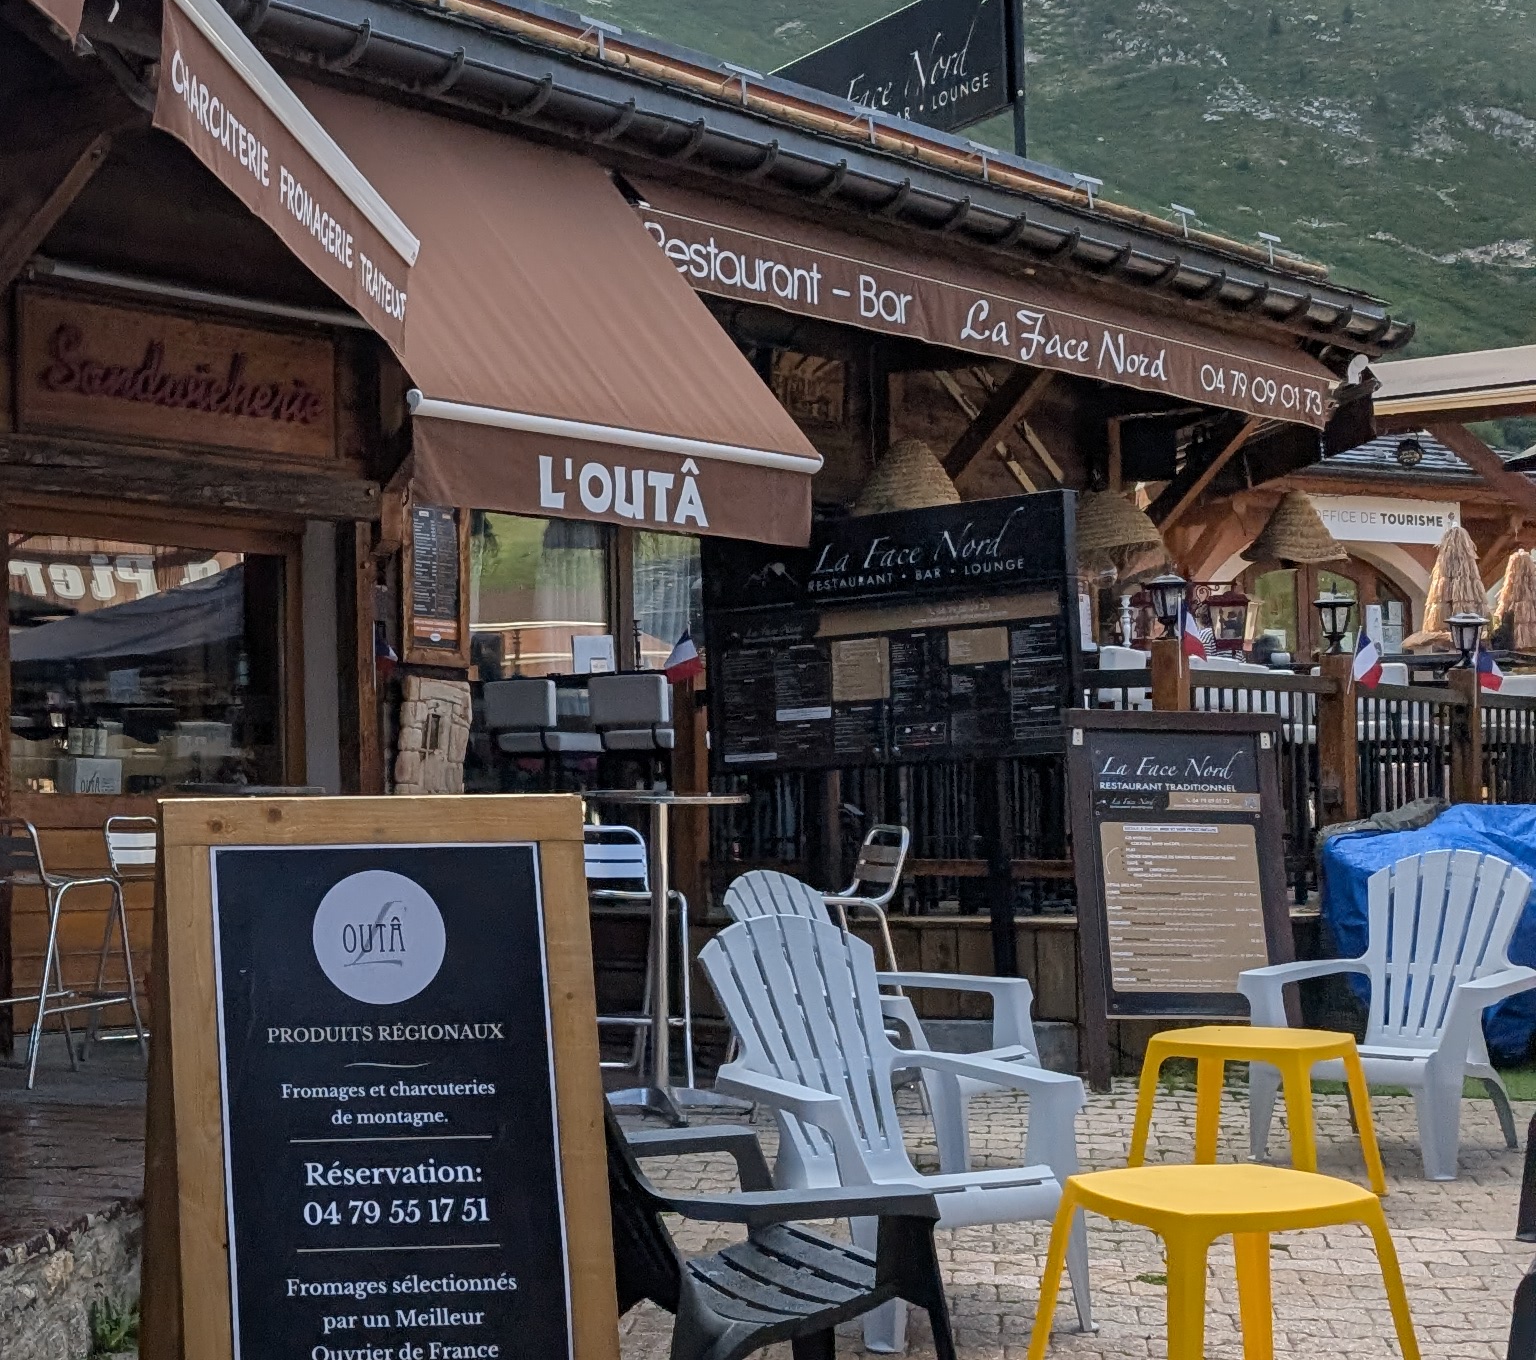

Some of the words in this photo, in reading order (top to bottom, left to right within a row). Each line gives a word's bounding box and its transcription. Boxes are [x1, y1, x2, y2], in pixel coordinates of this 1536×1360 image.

[932, 72, 989, 110] LOUNGE
[171, 49, 269, 186] CHARCUTERIE
[280, 166, 354, 270] FROMAGERIE
[859, 275, 912, 324] Bar
[960, 299, 1010, 346] La
[1016, 308, 1089, 363] Face
[1098, 330, 1168, 381] Nord
[1200, 364, 1225, 394] 04
[1230, 370, 1247, 398] 79
[1252, 376, 1276, 405] 09
[1281, 384, 1299, 410] 01
[1304, 388, 1322, 416] 73
[1361, 512, 1376, 524] DE
[1380, 513, 1443, 527] TOURISME
[812, 543, 849, 574] La
[863, 536, 921, 569] Face
[934, 507, 1025, 561] Nord
[808, 572, 893, 592] RESTAURANT
[915, 569, 941, 581] BAR
[965, 558, 1024, 575] LOUNGE
[1099, 756, 1130, 775] La
[1136, 756, 1177, 776] Face
[1185, 751, 1243, 779] Nord
[1099, 782, 1163, 790] RESTAURANT
[1165, 783, 1237, 792] TRADITIONNEL
[267, 1025, 373, 1044] PRODUITS
[378, 1022, 504, 1042] RÉGIONAUX
[281, 1083, 366, 1102] Fromages
[369, 1083, 387, 1097] et
[390, 1080, 496, 1097] charcuteries
[331, 1109, 353, 1125] de
[357, 1108, 448, 1128] montagne.
[304, 1159, 483, 1186] Réservation:
[303, 1201, 341, 1226] 04
[349, 1201, 381, 1224] 79
[388, 1199, 421, 1224] 55
[428, 1198, 454, 1223] 17
[461, 1198, 490, 1222] 51
[286, 1278, 387, 1299] Fromages
[393, 1273, 517, 1294] sélectionnés
[323, 1314, 356, 1334] par
[363, 1313, 389, 1328] un
[396, 1309, 485, 1327] Meilleur
[399, 1344, 423, 1360] de
[429, 1342, 499, 1360] France
